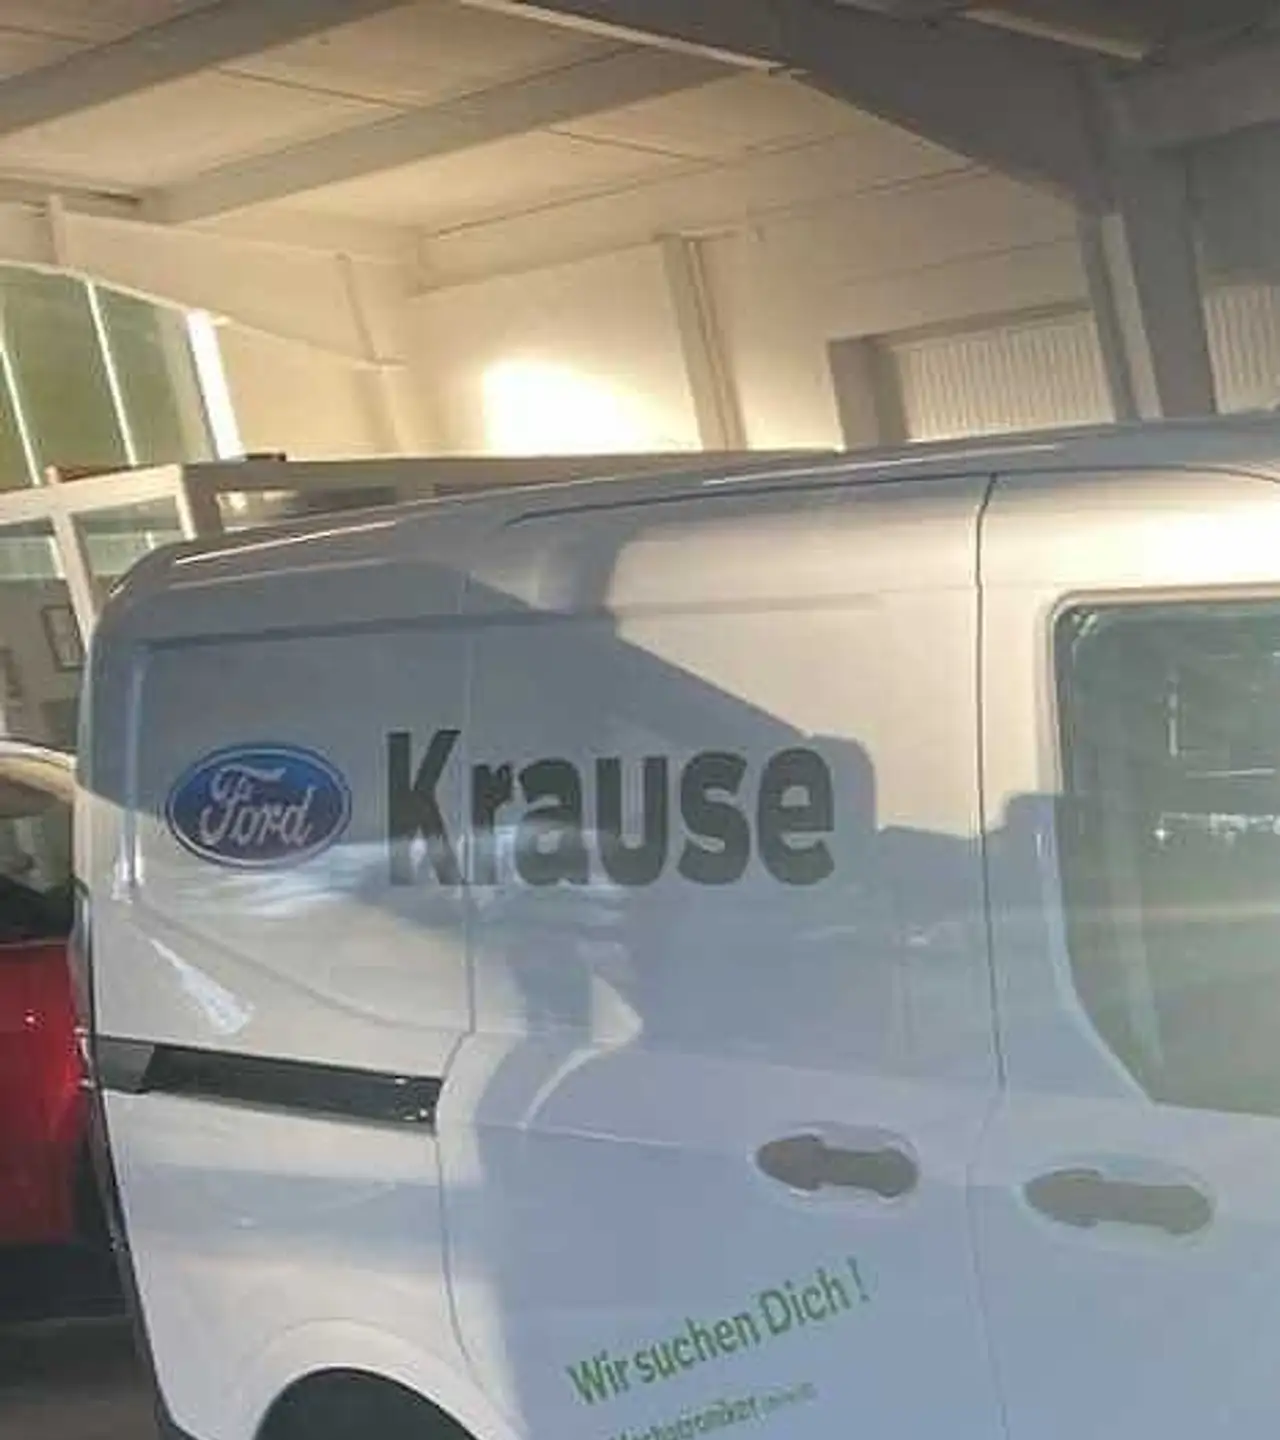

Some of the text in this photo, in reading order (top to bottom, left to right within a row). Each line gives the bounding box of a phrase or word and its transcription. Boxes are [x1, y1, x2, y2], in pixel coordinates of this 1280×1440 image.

[384, 727, 836, 887] Krause
[564, 1348, 631, 1405] Wir
[632, 1316, 762, 1385] suchen
[758, 1266, 852, 1336] Dich
